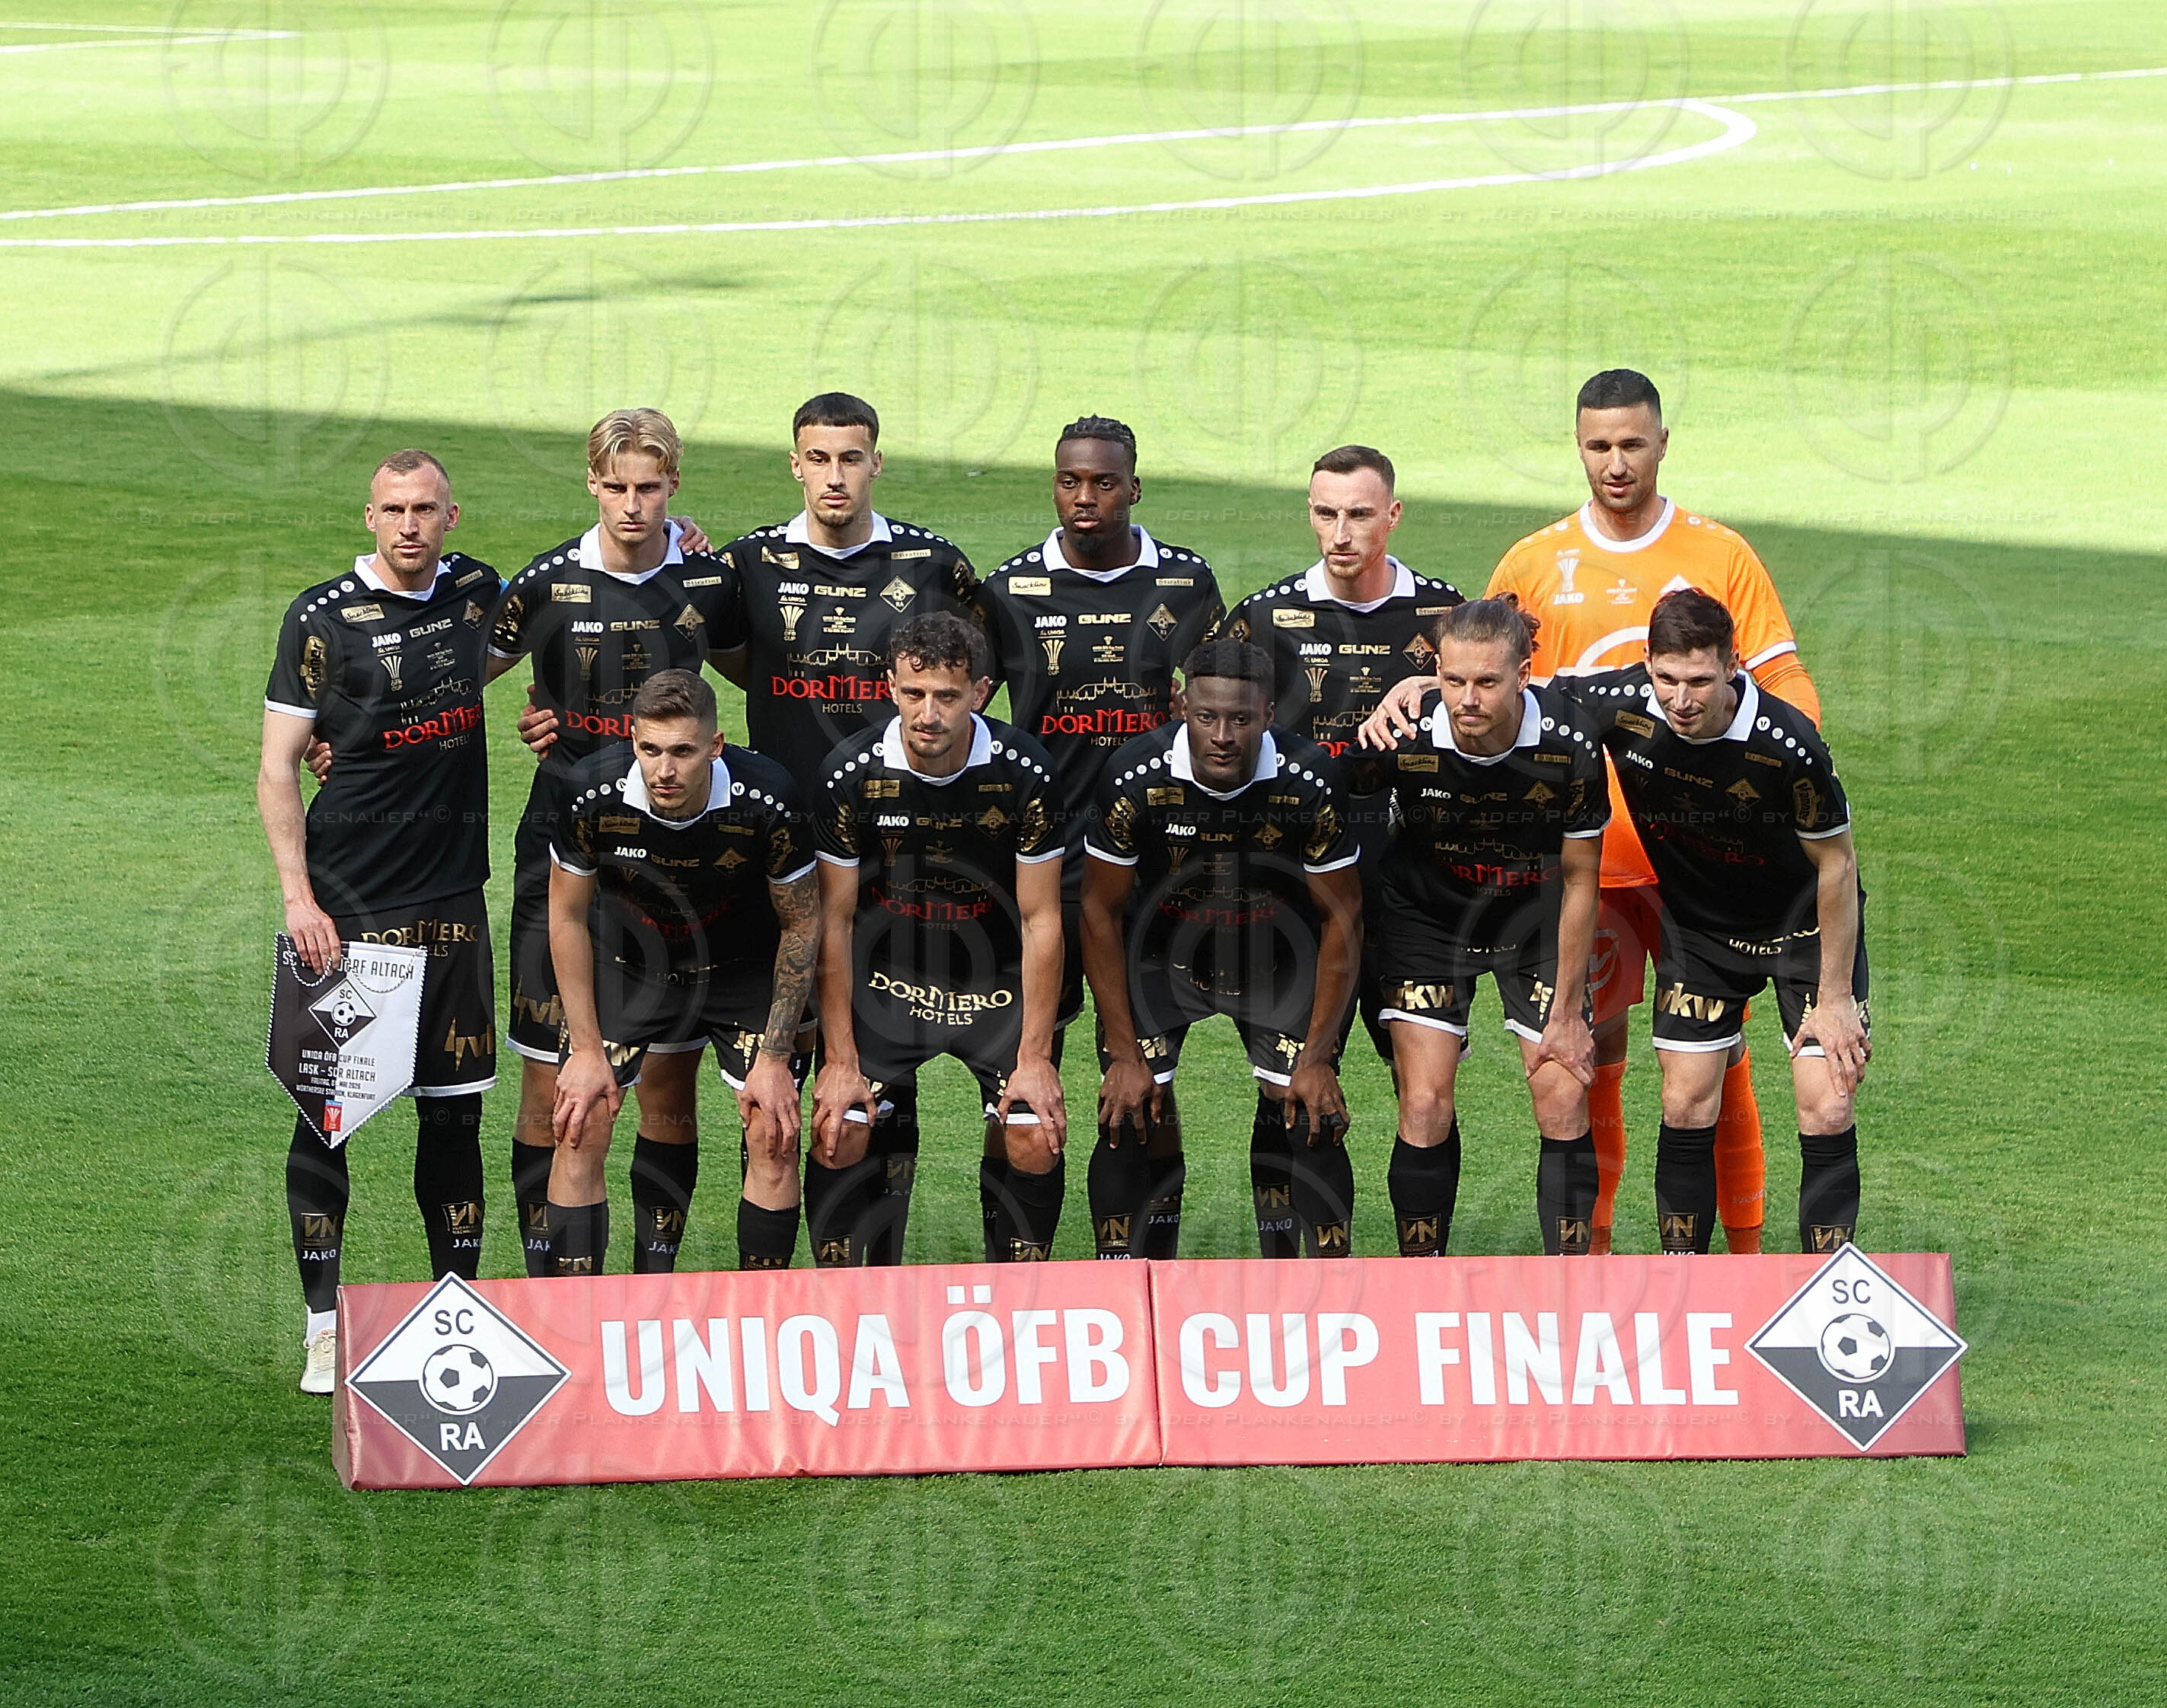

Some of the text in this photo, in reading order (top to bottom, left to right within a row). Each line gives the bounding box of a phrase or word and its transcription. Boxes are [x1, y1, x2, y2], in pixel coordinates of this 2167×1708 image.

[777, 582, 809, 595] JAKO
[814, 585, 866, 598] GUNZ
[1553, 592, 1585, 605] JAKO
[610, 618, 660, 632] GUNZ
[1034, 615, 1068, 628] JAKO
[1078, 613, 1132, 625] GUNZ
[409, 618, 453, 638] GUNZ
[571, 621, 604, 634] JAKO
[372, 633, 402, 648] JAKO
[1299, 643, 1332, 656] JAKO
[1339, 644, 1391, 655] GUNZ
[771, 673, 892, 700] DORMER
[822, 703, 863, 714] HOTELS
[382, 704, 482, 749] DORMER
[439, 734, 470, 751] HOTEL
[1626, 750, 1654, 770] JAKO
[1664, 767, 1714, 789] GUNZ
[1420, 788, 1451, 800] JAKO
[877, 815, 909, 827] JAKO
[1165, 823, 1196, 836] JAKO
[614, 846, 647, 858] JAKO
[650, 854, 700, 867] GUNZ
[371, 961, 414, 980] ALTACH
[339, 989, 353, 999] SC
[868, 972, 1013, 1012] DORMERO
[909, 1006, 973, 1025] HOTELS
[334, 1026, 349, 1039] RA
[338, 1054, 352, 1064] CUP
[353, 1055, 375, 1067] FINALE
[298, 1062, 319, 1075] LASK
[346, 1068, 376, 1082] ALTACH
[1148, 1214, 1179, 1224] JAKO
[1259, 1218, 1293, 1231] JAKO
[305, 1215, 339, 1237] VN
[1661, 1215, 1694, 1237] VN
[302, 1249, 337, 1261] JAKO
[1831, 1278, 1872, 1304] SC
[434, 1308, 474, 1336] SC
[600, 1285, 1740, 1428] UNIQA ÖFB CUP FINALE
[1838, 1389, 1885, 1419] RA
[439, 1422, 486, 1451] RA
